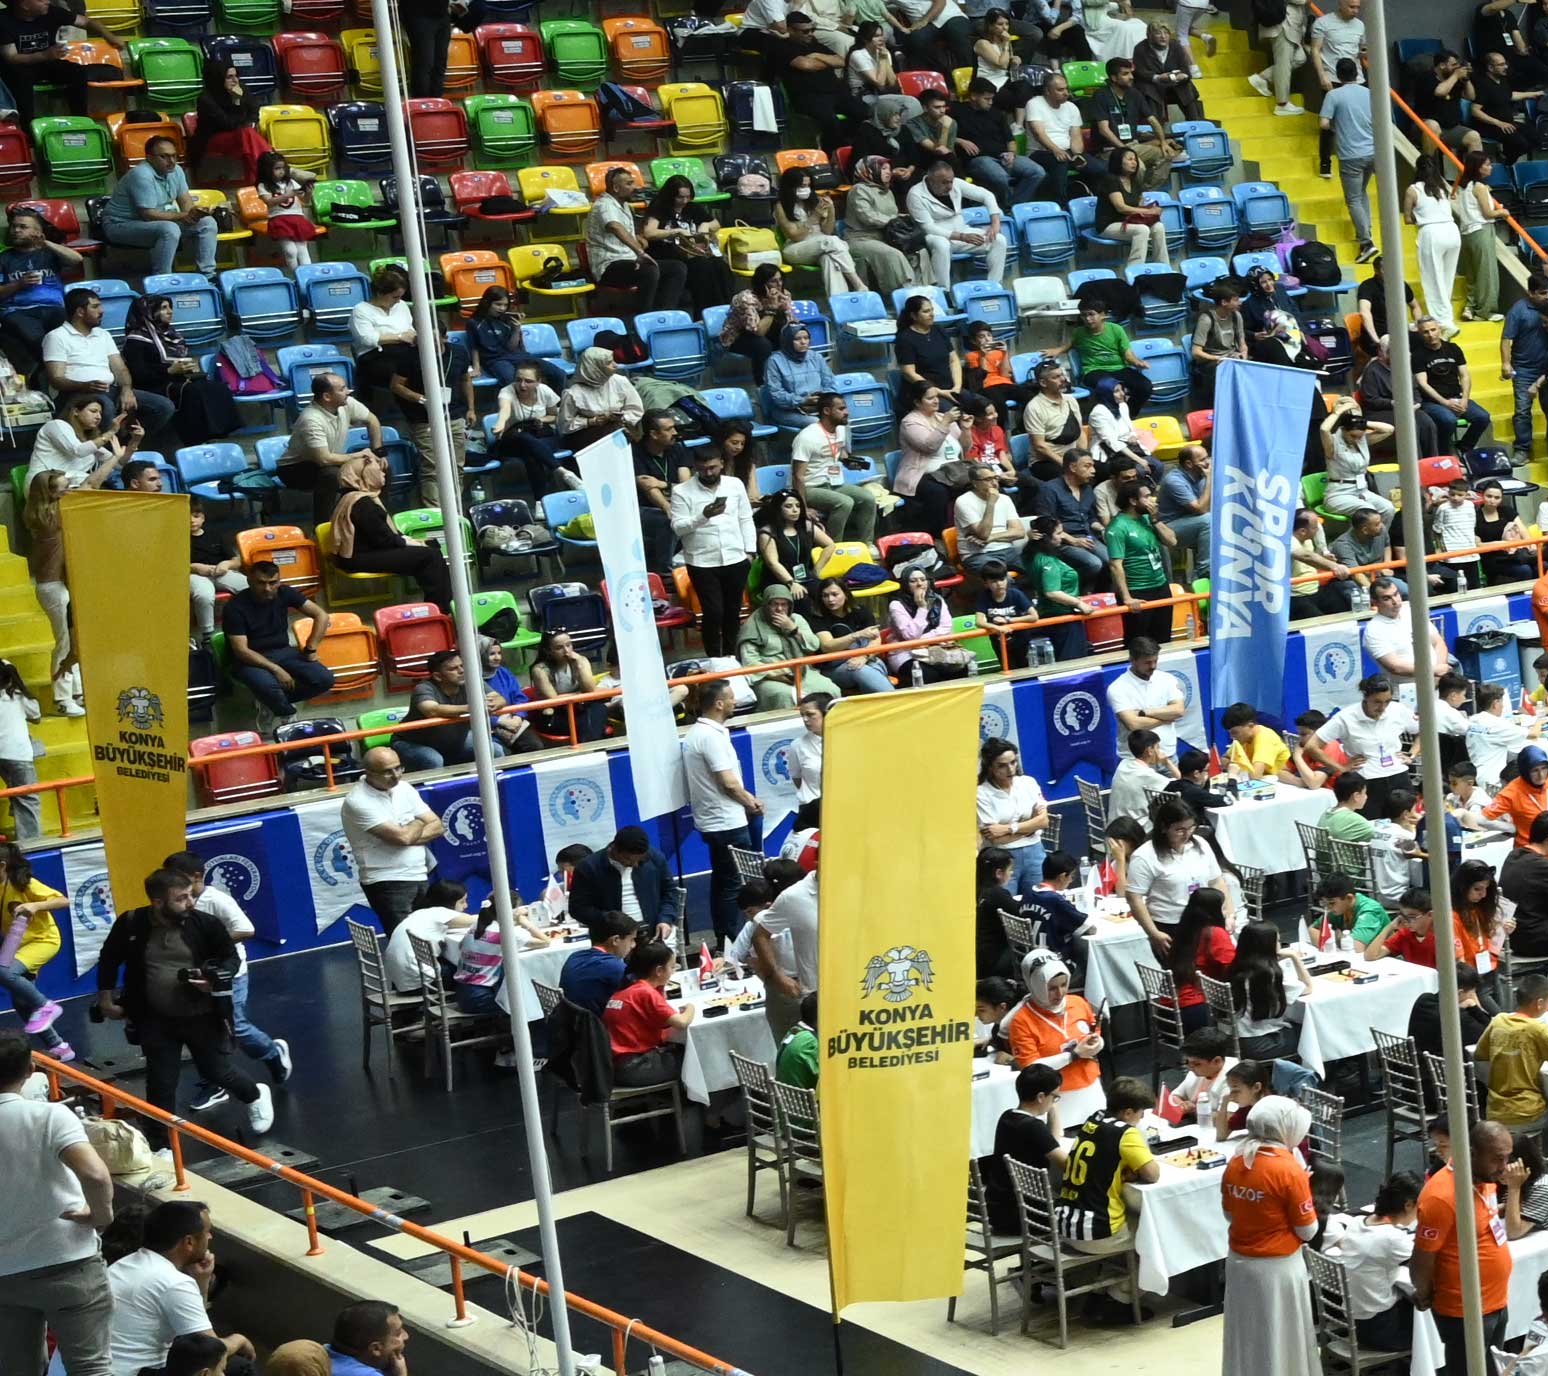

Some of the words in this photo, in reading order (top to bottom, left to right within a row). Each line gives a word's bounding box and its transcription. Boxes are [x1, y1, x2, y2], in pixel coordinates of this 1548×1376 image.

[1216, 463, 1256, 641] KONYA
[1255, 472, 1292, 614] SPOR
[118, 730, 166, 750] KONYA
[93, 741, 186, 773] BÜYÜKŞEHİR
[116, 764, 171, 784] BELEDİYESİ
[858, 1003, 933, 1026] KONYA
[827, 1018, 971, 1059] BÜYÜKŞEHİR
[847, 1047, 940, 1070] BELEDİYESİ
